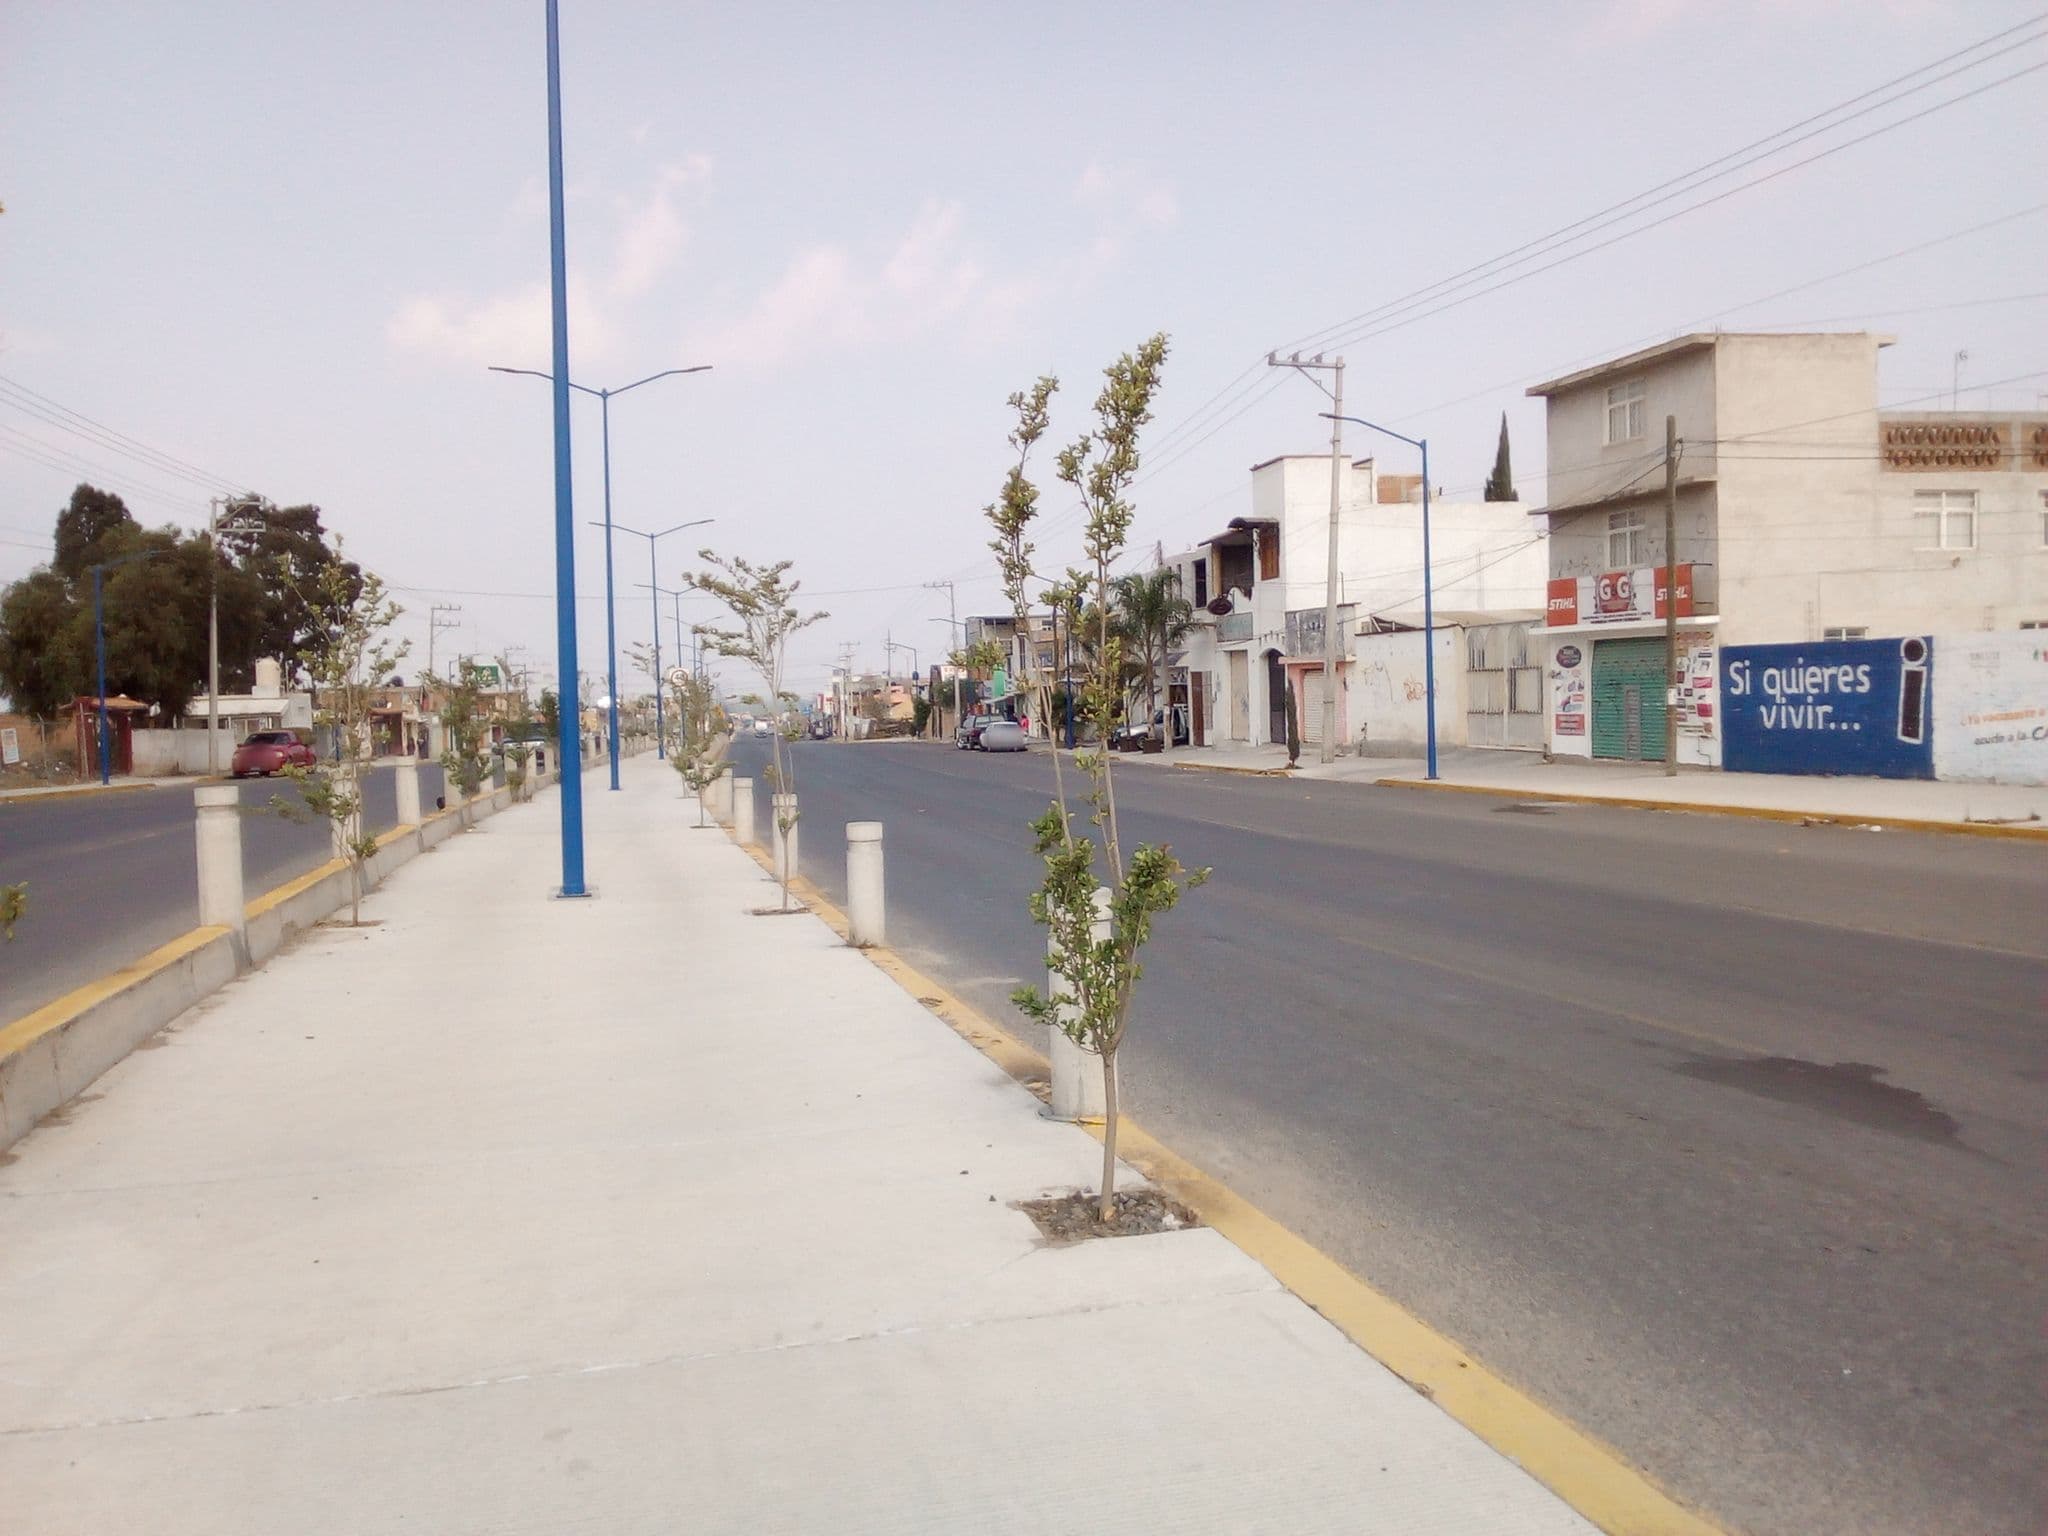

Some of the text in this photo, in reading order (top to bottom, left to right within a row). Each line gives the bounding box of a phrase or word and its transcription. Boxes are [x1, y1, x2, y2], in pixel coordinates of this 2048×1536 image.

[1548, 597, 1575, 611] STIHL
[1656, 585, 1688, 600] STHL
[1729, 657, 1871, 704] Si quieres
[1760, 695, 1861, 731] vivir...
